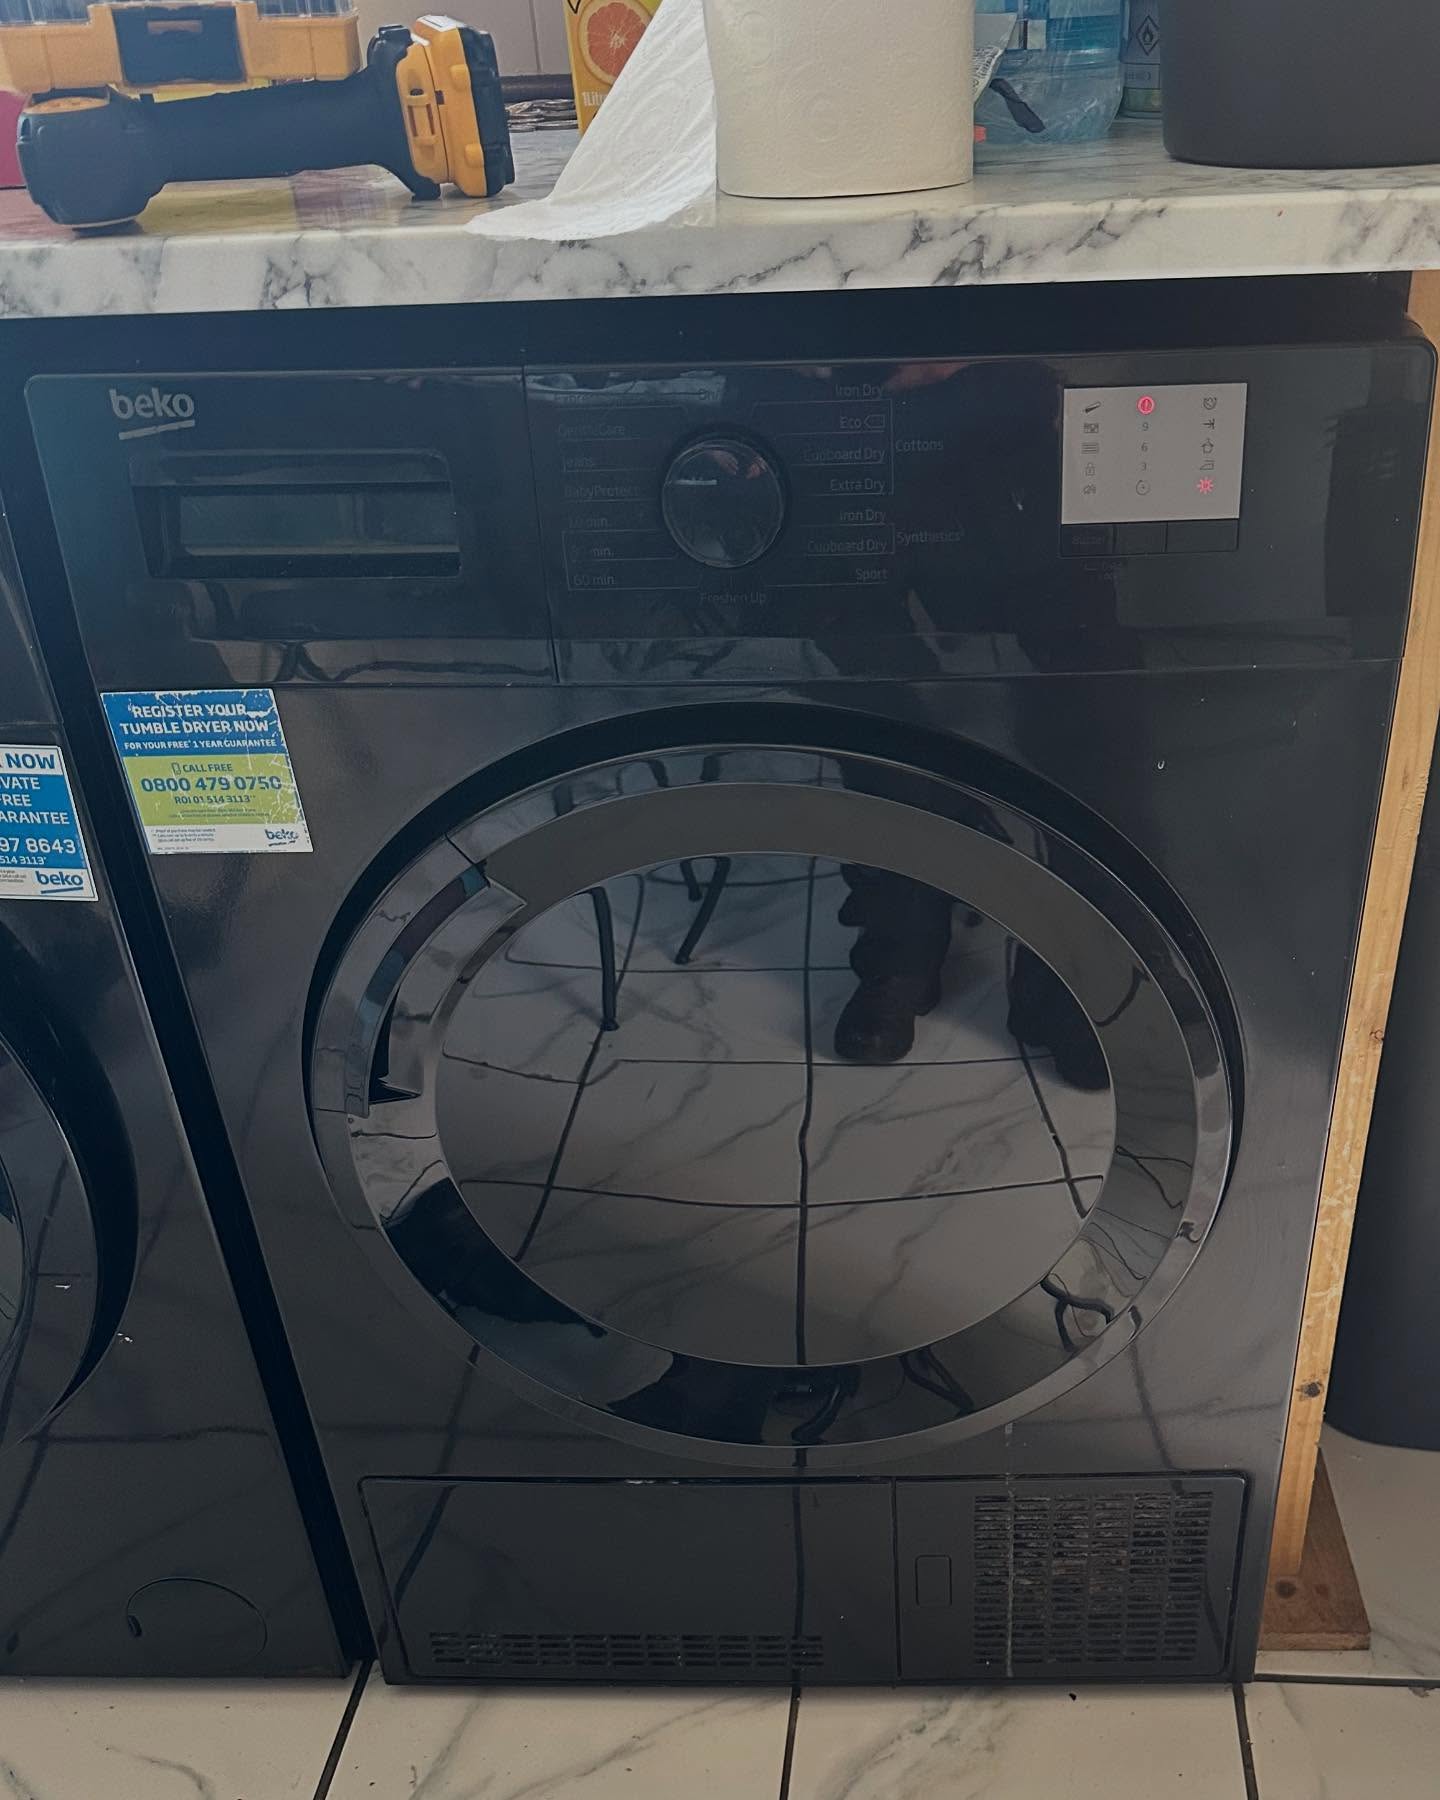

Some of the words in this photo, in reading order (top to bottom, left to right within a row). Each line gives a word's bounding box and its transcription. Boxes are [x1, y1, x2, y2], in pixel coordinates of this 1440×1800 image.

[835, 384, 860, 396] Iron
[863, 384, 884, 398] Dry
[109, 387, 194, 419] beko
[840, 415, 862, 429] Eco
[895, 438, 944, 452] Cottons
[864, 449, 886, 463] Dry
[830, 479, 862, 492] Extra
[864, 478, 886, 494] Dry
[840, 511, 863, 521] Iron
[866, 509, 887, 523] Dry
[808, 540, 864, 554] Cupboard
[866, 539, 887, 555] Dry
[855, 568, 888, 583] Sport
[750, 591, 766, 604] Up
[131, 704, 204, 718] REGISTER
[205, 703, 247, 716] YOUR
[120, 721, 181, 735] TUMBLE
[182, 719, 232, 734] DRYER
[233, 719, 269, 732] NOW
[124, 742, 142, 750] FOR
[142, 741, 167, 750] YOUR
[199, 740, 223, 748] YEAR
[223, 739, 277, 748] GUARANTEE
[5, 752, 55, 769] NOW
[182, 764, 207, 773] CALL
[208, 763, 233, 772] FREE
[0, 776, 41, 790] VATE
[141, 777, 191, 792] 0800
[195, 776, 231, 791] 479
[234, 775, 282, 790] 0750
[174, 796, 192, 804] ROI
[206, 795, 225, 804] 514
[25, 838, 76, 854] 8643
[35, 870, 84, 886] beko
